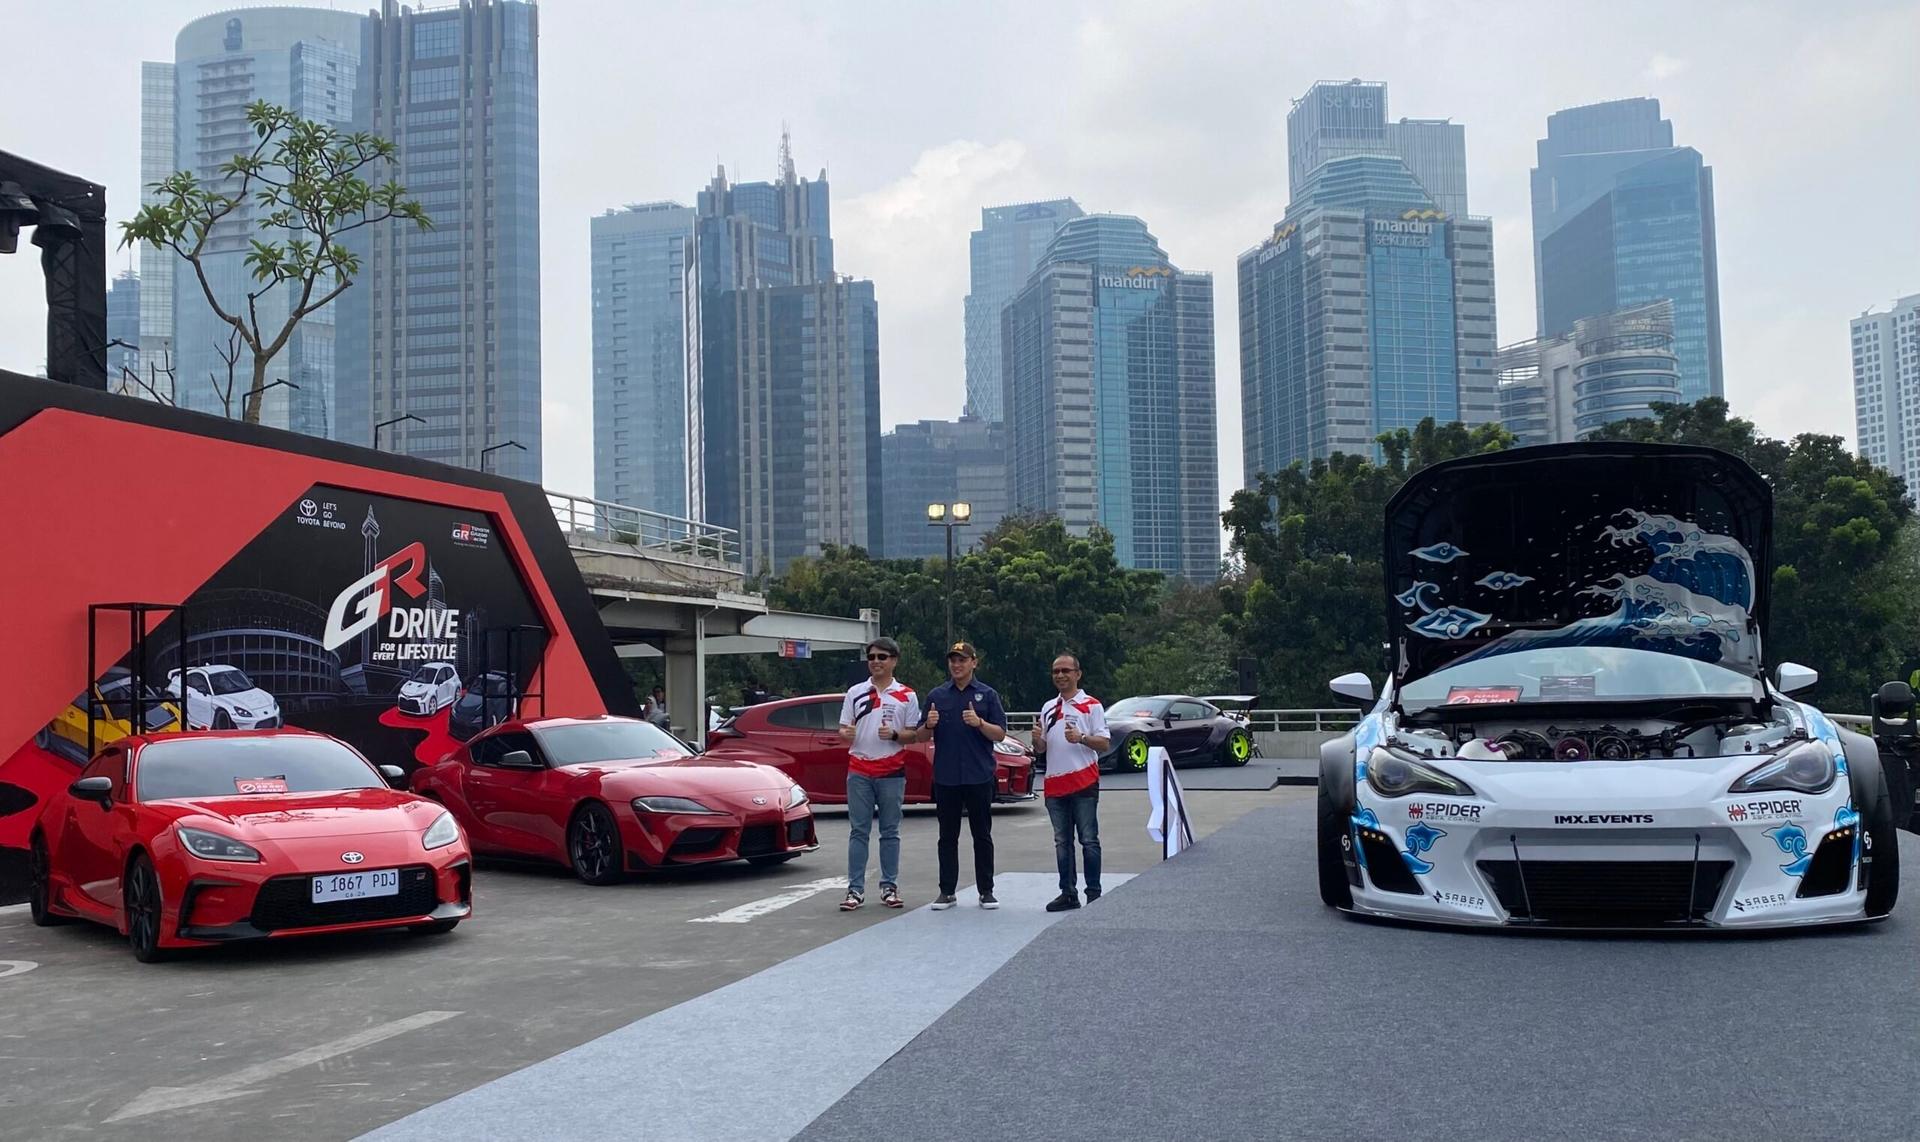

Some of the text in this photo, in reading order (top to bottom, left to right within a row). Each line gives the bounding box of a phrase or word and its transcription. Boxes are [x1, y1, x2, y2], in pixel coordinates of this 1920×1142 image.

[1098, 273, 1157, 289] mandiri
[323, 502, 337, 511] LET'S
[297, 516, 320, 526] TOYOTA
[323, 511, 333, 519] GO
[323, 520, 346, 530] BEYOND
[452, 529, 469, 540] GR
[323, 541, 427, 651] GR
[388, 607, 459, 638] DRIVE
[380, 643, 395, 651] FOR
[397, 643, 457, 660] LIFESTYLE
[372, 652, 395, 660] EVERY
[1426, 803, 1480, 817] SPIDER
[1748, 800, 1801, 815] SPIDER
[1554, 814, 1654, 824] IMX.EVENTS
[315, 872, 396, 894] B 1867 PDJ
[1445, 892, 1484, 905] SABER
[1745, 893, 1785, 906] SABER
